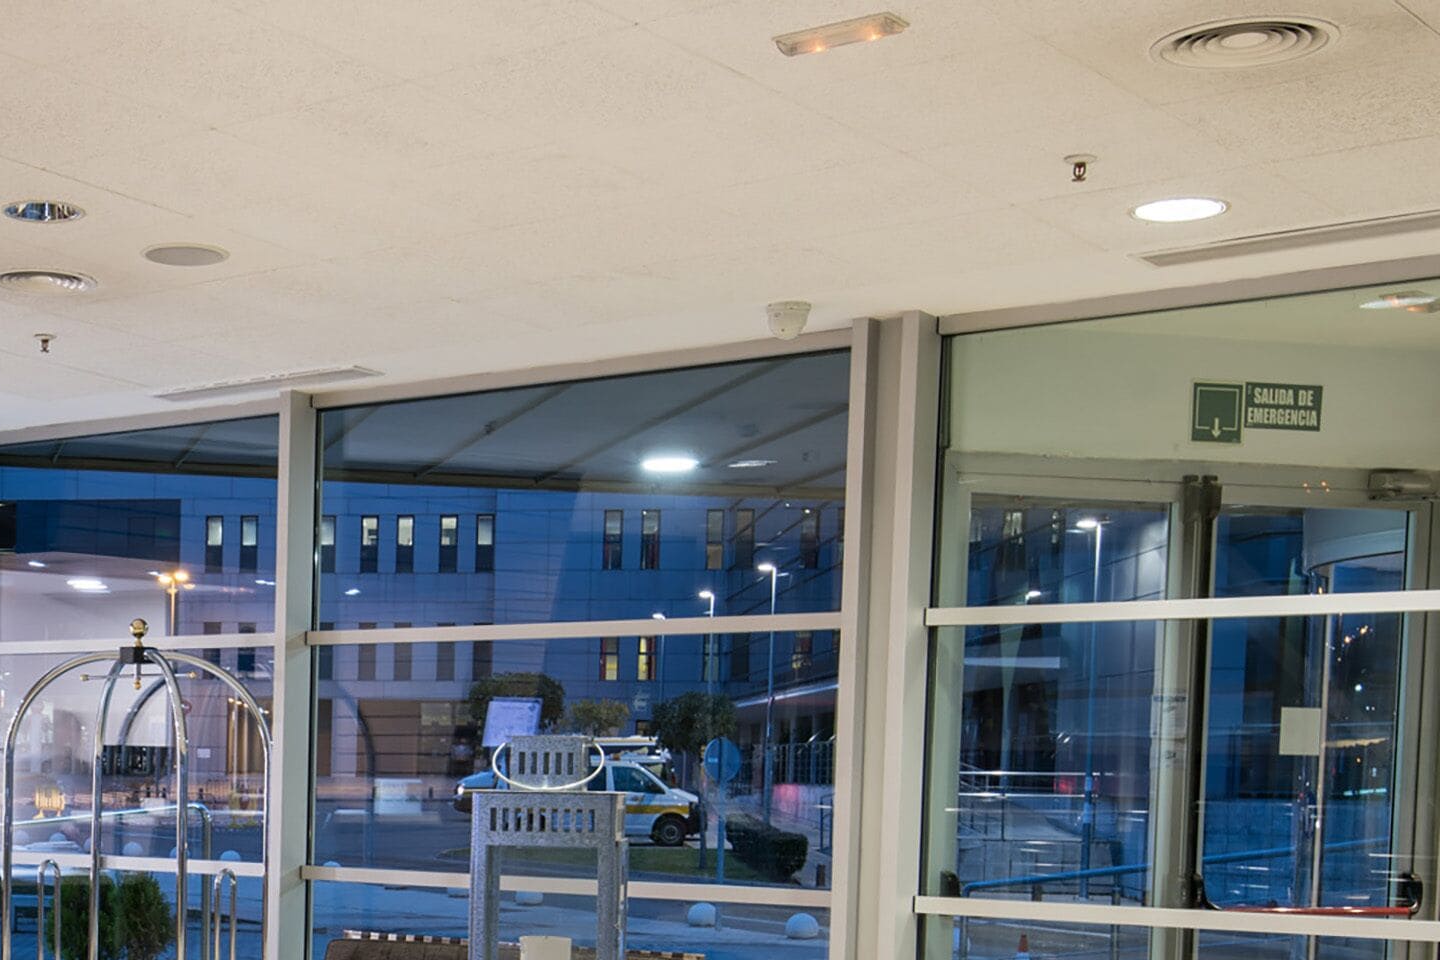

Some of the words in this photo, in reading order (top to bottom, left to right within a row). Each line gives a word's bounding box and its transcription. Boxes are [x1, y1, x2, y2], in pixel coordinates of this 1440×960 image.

[1253, 387, 1294, 406] SALIDA
[1298, 389, 1314, 406] DE
[1247, 407, 1318, 427] EMERGENCIA
